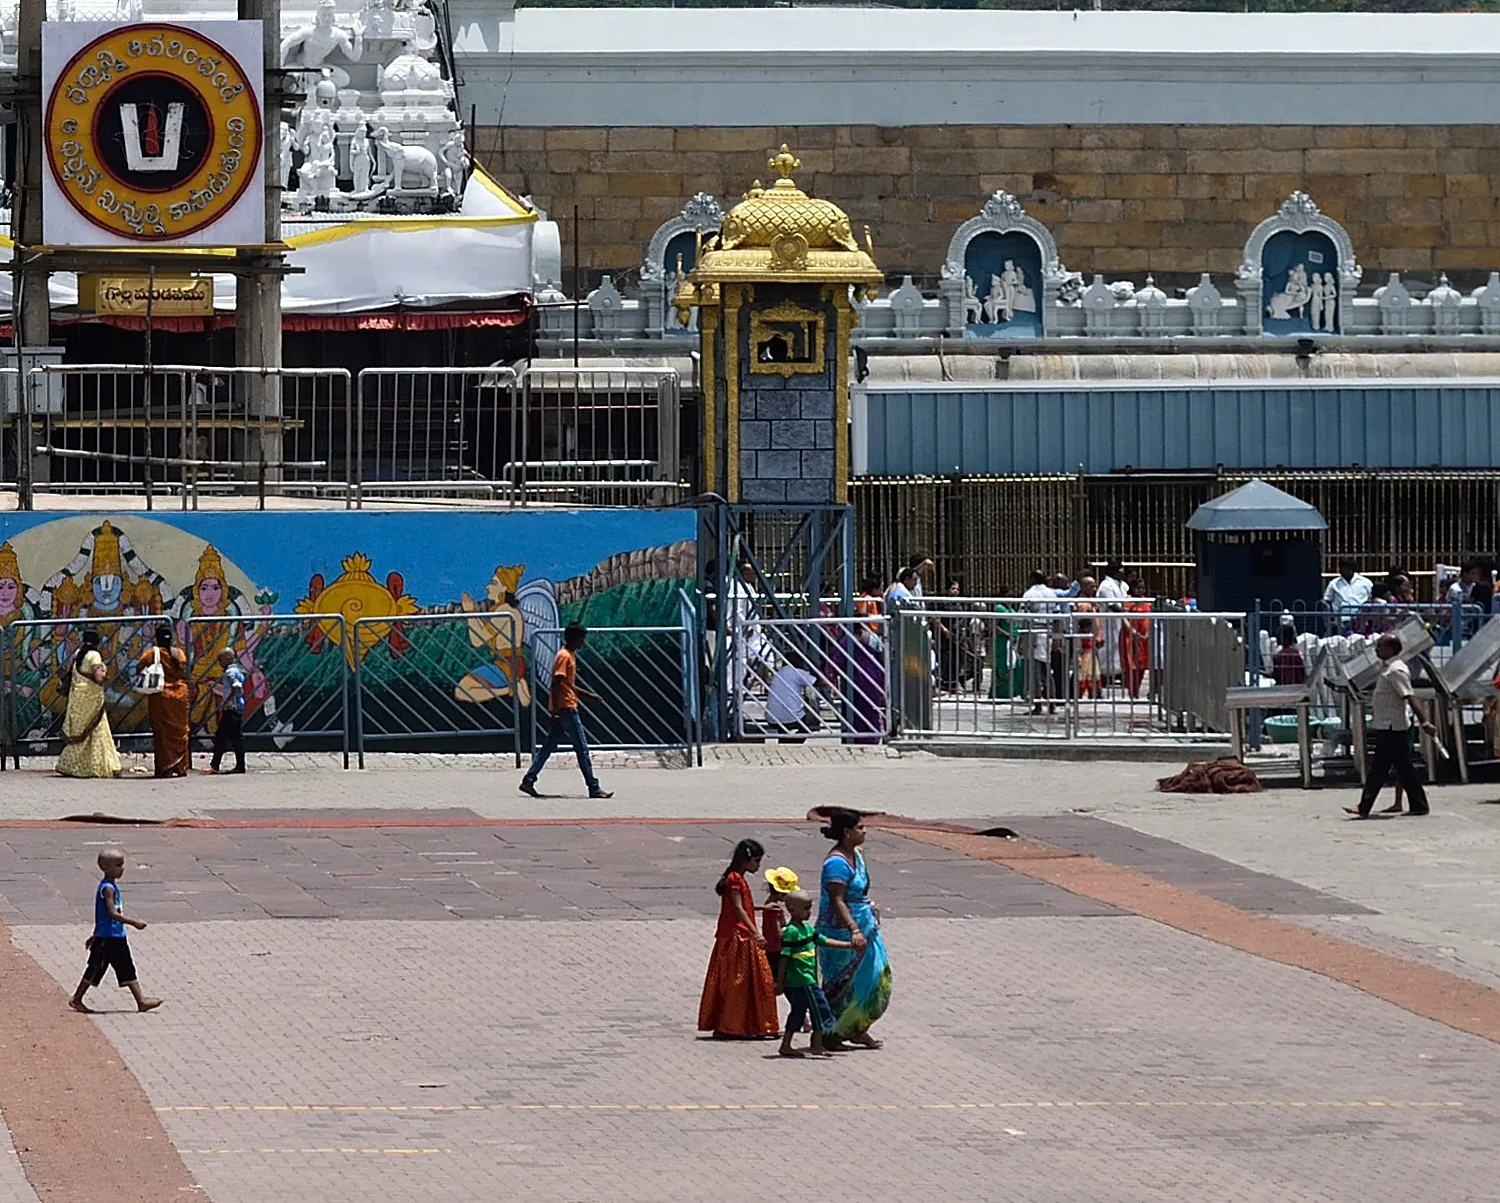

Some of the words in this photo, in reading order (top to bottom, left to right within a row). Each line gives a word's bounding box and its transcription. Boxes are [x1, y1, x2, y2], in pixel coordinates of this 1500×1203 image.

[65, 49, 128, 105] ధర్మాన్ని
[127, 34, 244, 103] ఆచరించండి
[168, 116, 246, 221] కాపాడుతుంది
[105, 287, 132, 305] గొల్ల
